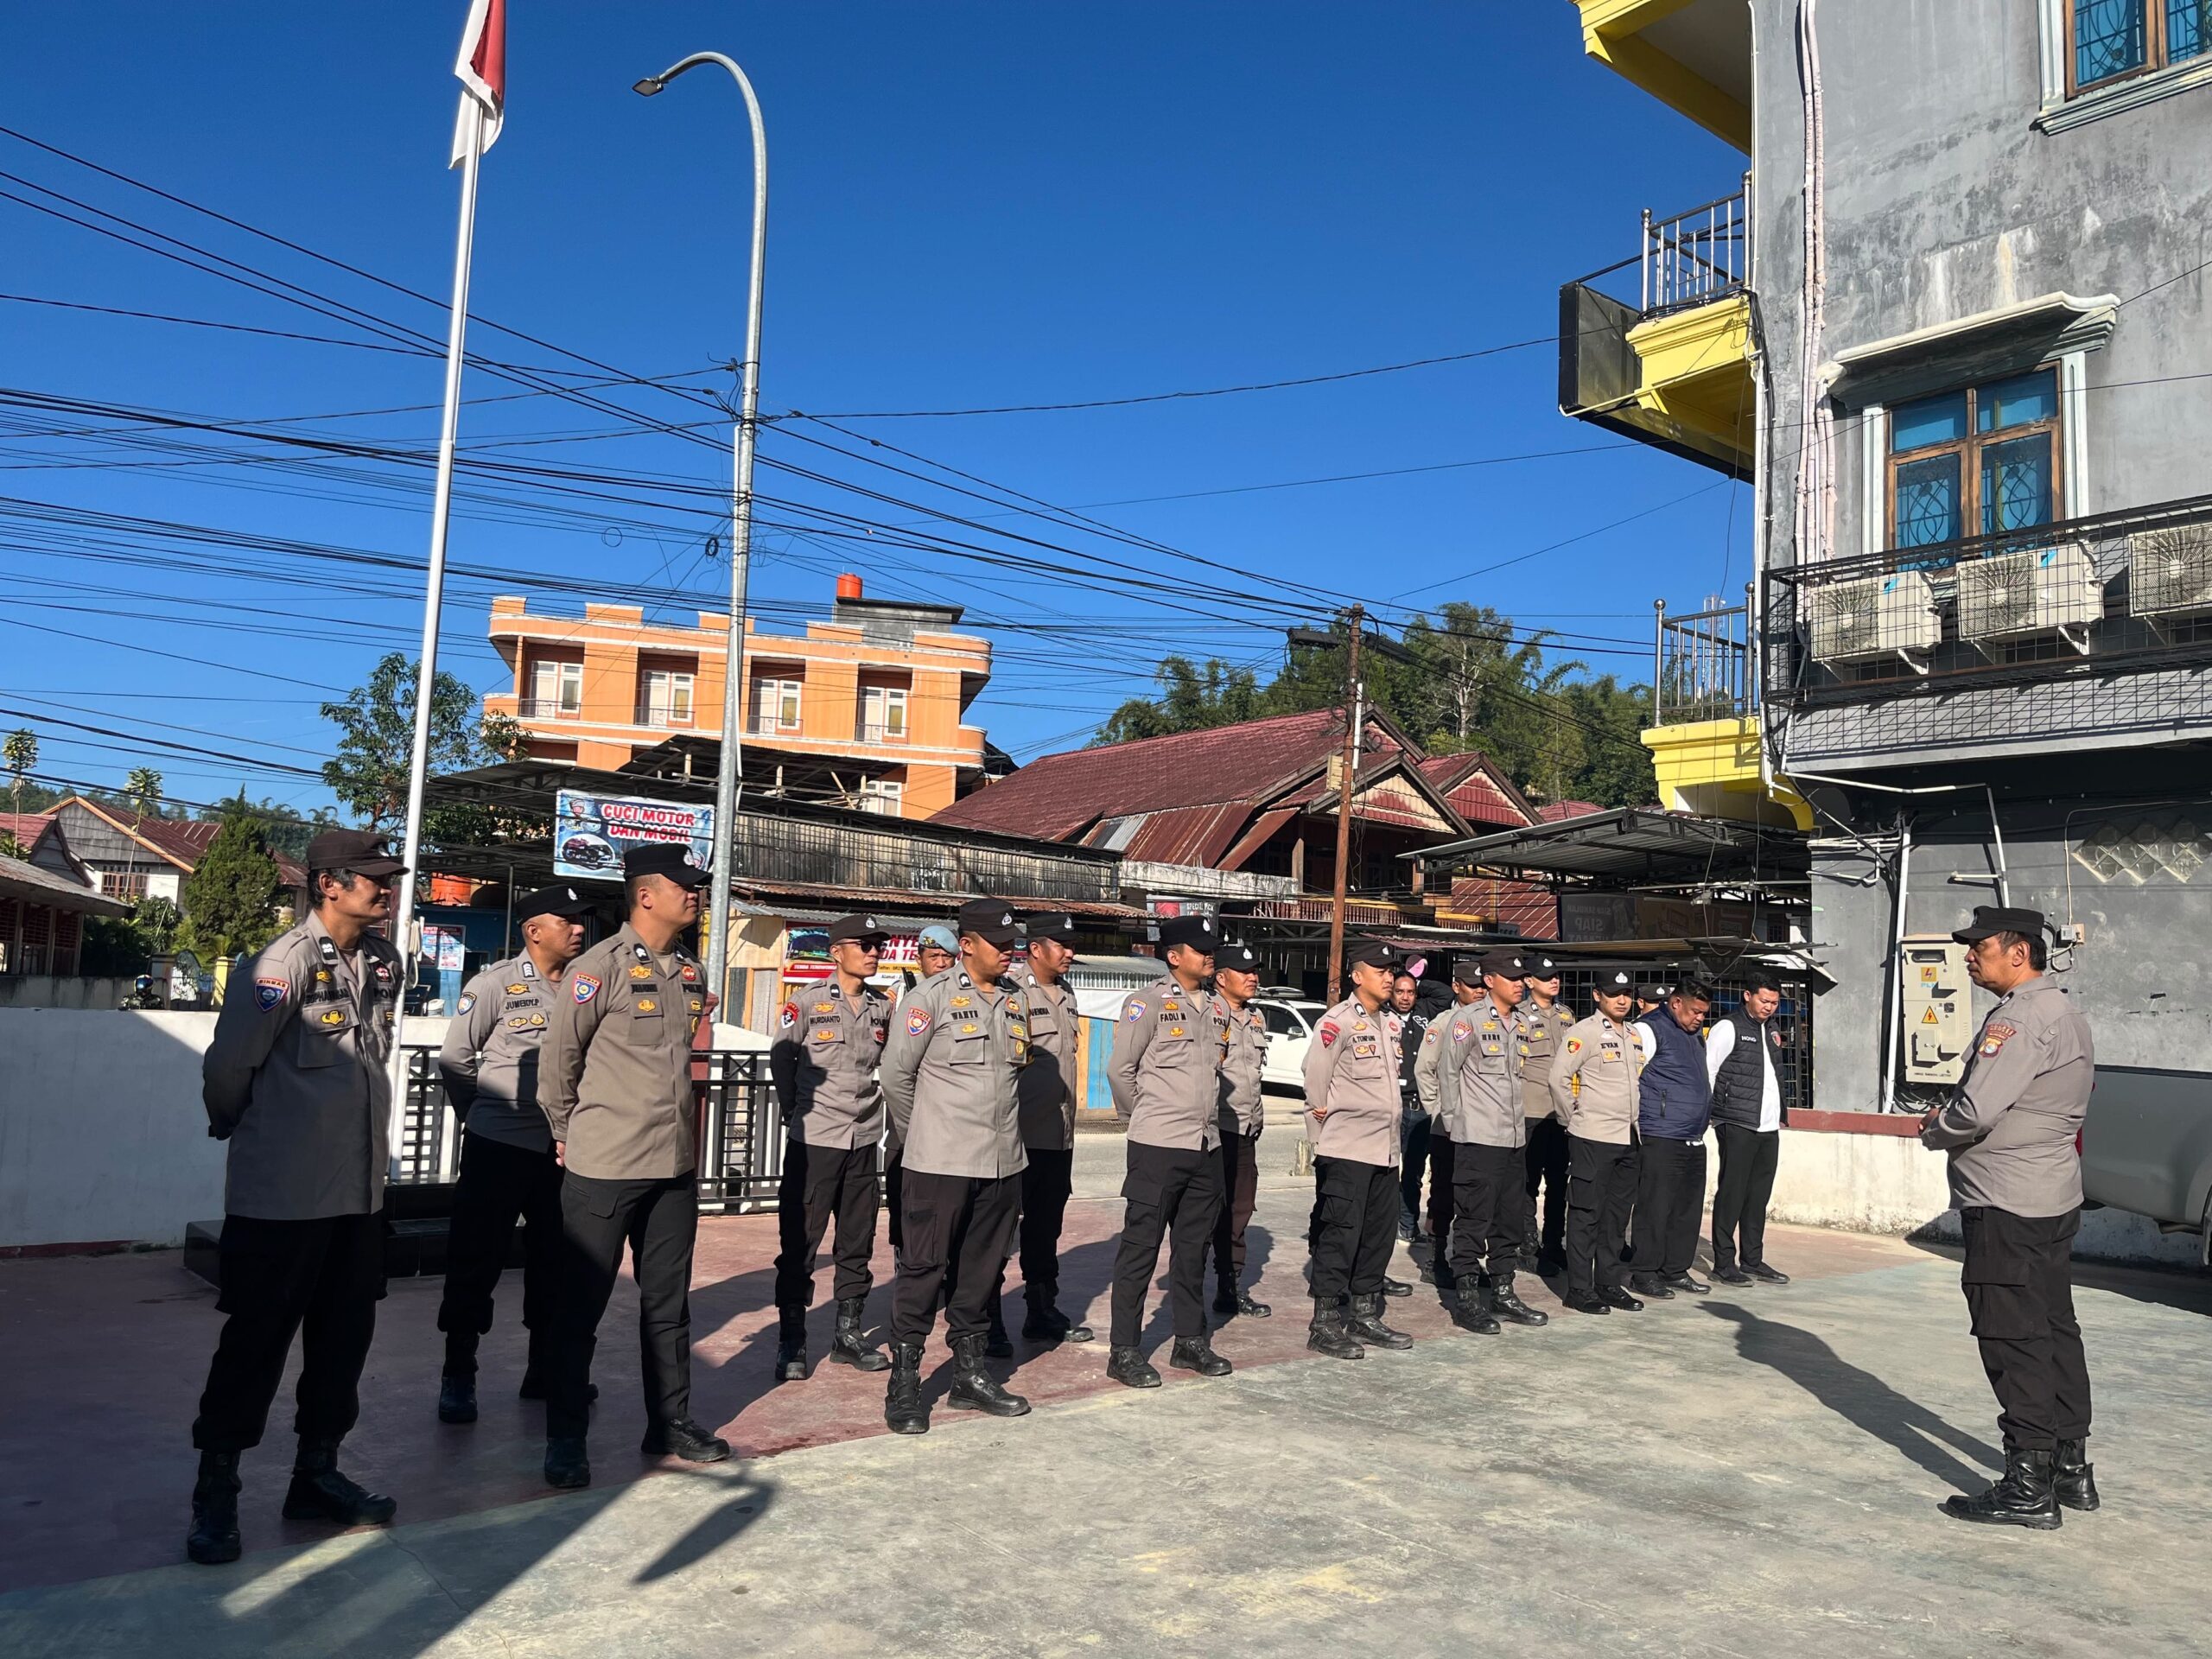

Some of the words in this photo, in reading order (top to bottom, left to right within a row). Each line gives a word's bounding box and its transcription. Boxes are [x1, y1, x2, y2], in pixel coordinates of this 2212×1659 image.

[602, 804, 638, 821] CUCI
[642, 807, 695, 826] MOTOR
[609, 823, 640, 838] DAN
[644, 827, 692, 842] MOBIL
[1160, 1013, 1179, 1022] FADLI
